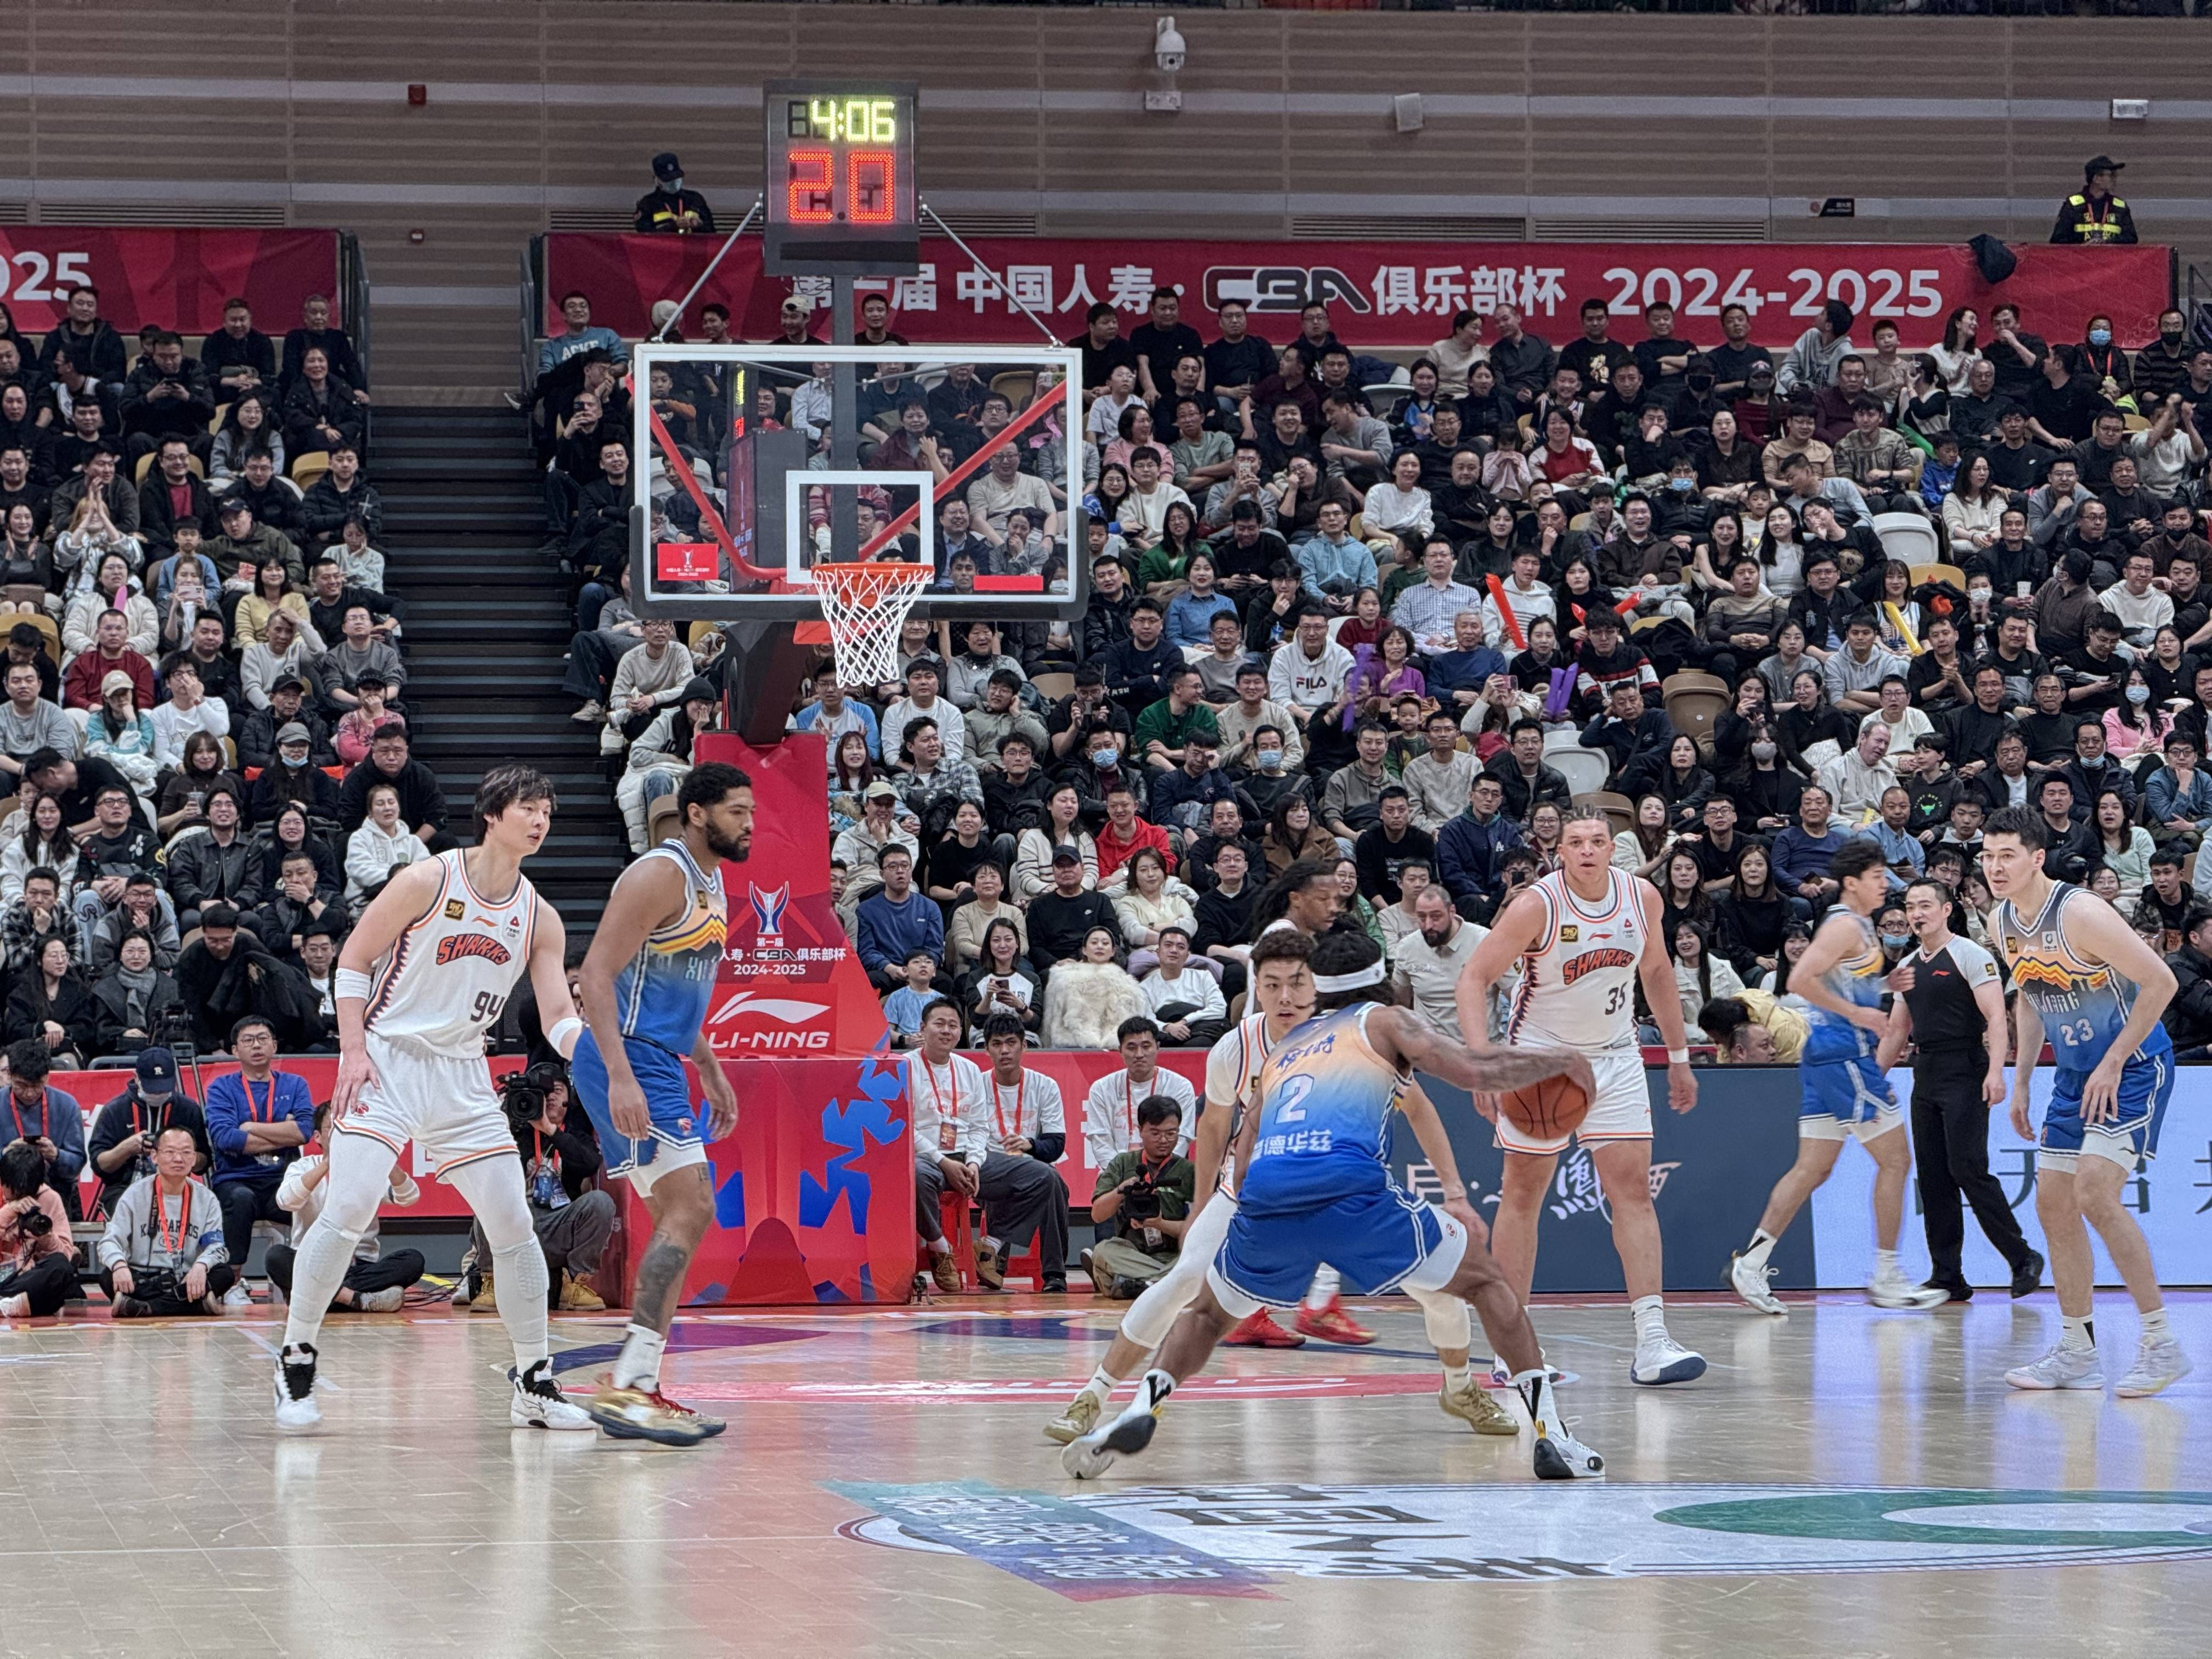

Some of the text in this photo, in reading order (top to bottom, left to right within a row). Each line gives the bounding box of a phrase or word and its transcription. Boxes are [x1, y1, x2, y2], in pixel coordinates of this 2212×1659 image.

[811, 99, 895, 142] 4:06
[0, 251, 92, 302] 25
[1602, 268, 1943, 317] 2024-2025
[1296, 676, 1327, 690] FILA
[436, 933, 511, 966] SHARKS
[757, 938, 784, 947] 第一届
[796, 948, 847, 961] 俱乐部杯
[733, 964, 806, 975] 2024-2025
[1563, 948, 1635, 985] SHARKS
[470, 991, 505, 1022] 94
[708, 1031, 830, 1049] LI-NING
[2059, 1018, 2095, 1046] 23
[1274, 1073, 1314, 1125] 2
